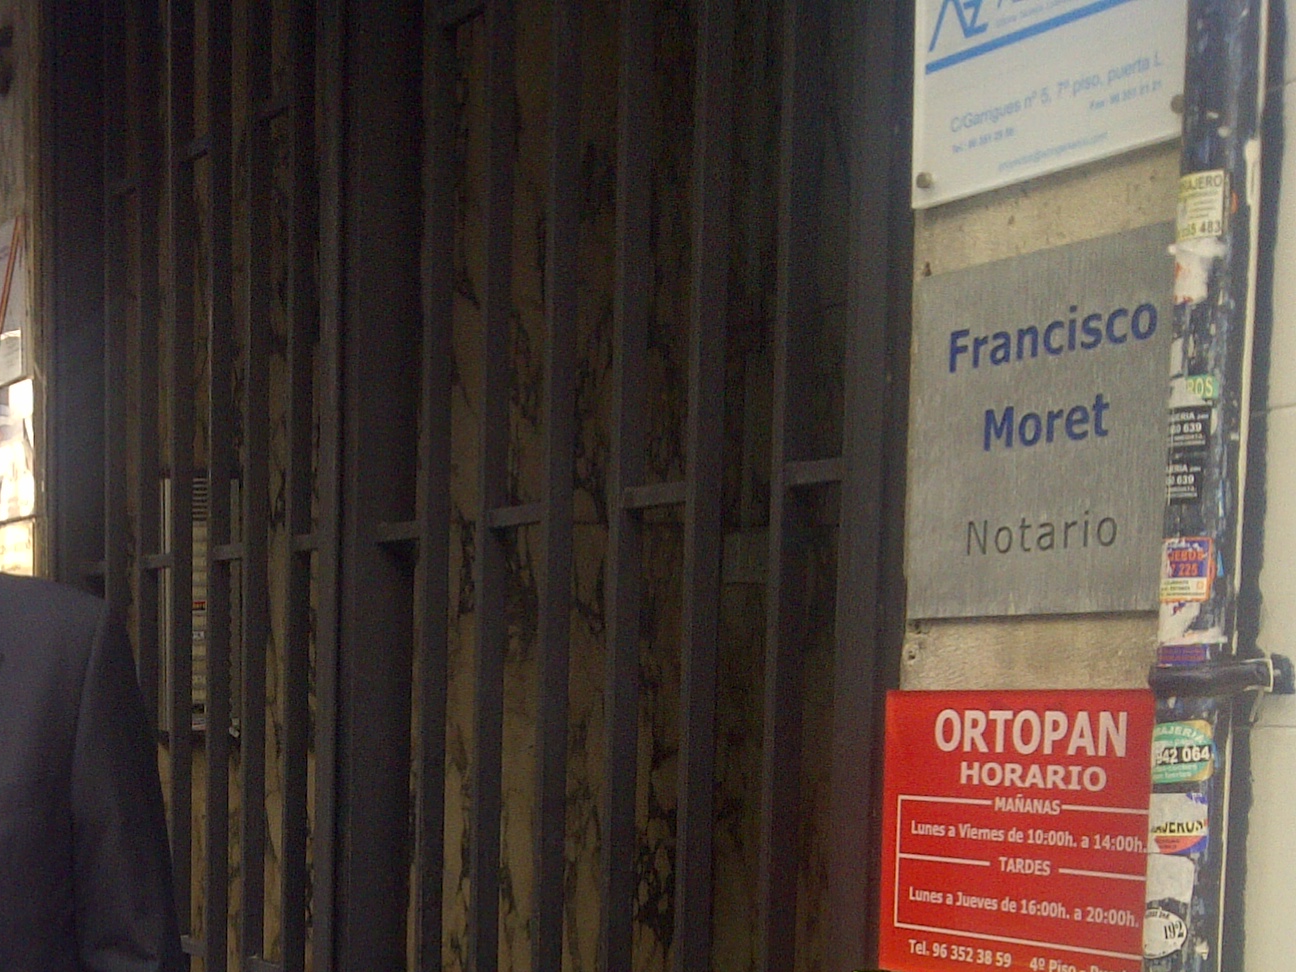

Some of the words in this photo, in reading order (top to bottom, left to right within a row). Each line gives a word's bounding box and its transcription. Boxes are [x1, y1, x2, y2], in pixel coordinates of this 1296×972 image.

[948, 303, 1158, 373] Francisco
[983, 393, 1109, 451] Moret
[966, 511, 1118, 556] Notario
[934, 708, 1128, 757] ORTOPAN
[1181, 746, 1210, 762] 064
[960, 761, 1107, 791] HORARIO
[994, 793, 1061, 815] MAÑANAS
[911, 820, 945, 836] Lunes
[948, 825, 956, 838] a
[958, 823, 1004, 842] Viernes
[1008, 827, 1024, 843] de
[1027, 829, 1077, 849] 10:00h.
[1081, 836, 1089, 849] a
[1094, 834, 1146, 854] 14:00h.
[999, 857, 1051, 875] TARDES
[909, 886, 943, 904] Lunes
[946, 893, 953, 905] a
[956, 892, 998, 911] Jueves
[1001, 897, 1017, 913] de
[1020, 899, 1070, 919] 16:00h.
[1074, 908, 1082, 920] a
[1086, 906, 1139, 928] 20:00h.
[908, 939, 930, 956] Tel.
[932, 943, 948, 959] 96
[950, 944, 974, 963] 352
[976, 948, 993, 966] 38
[995, 951, 1012, 968] 59
